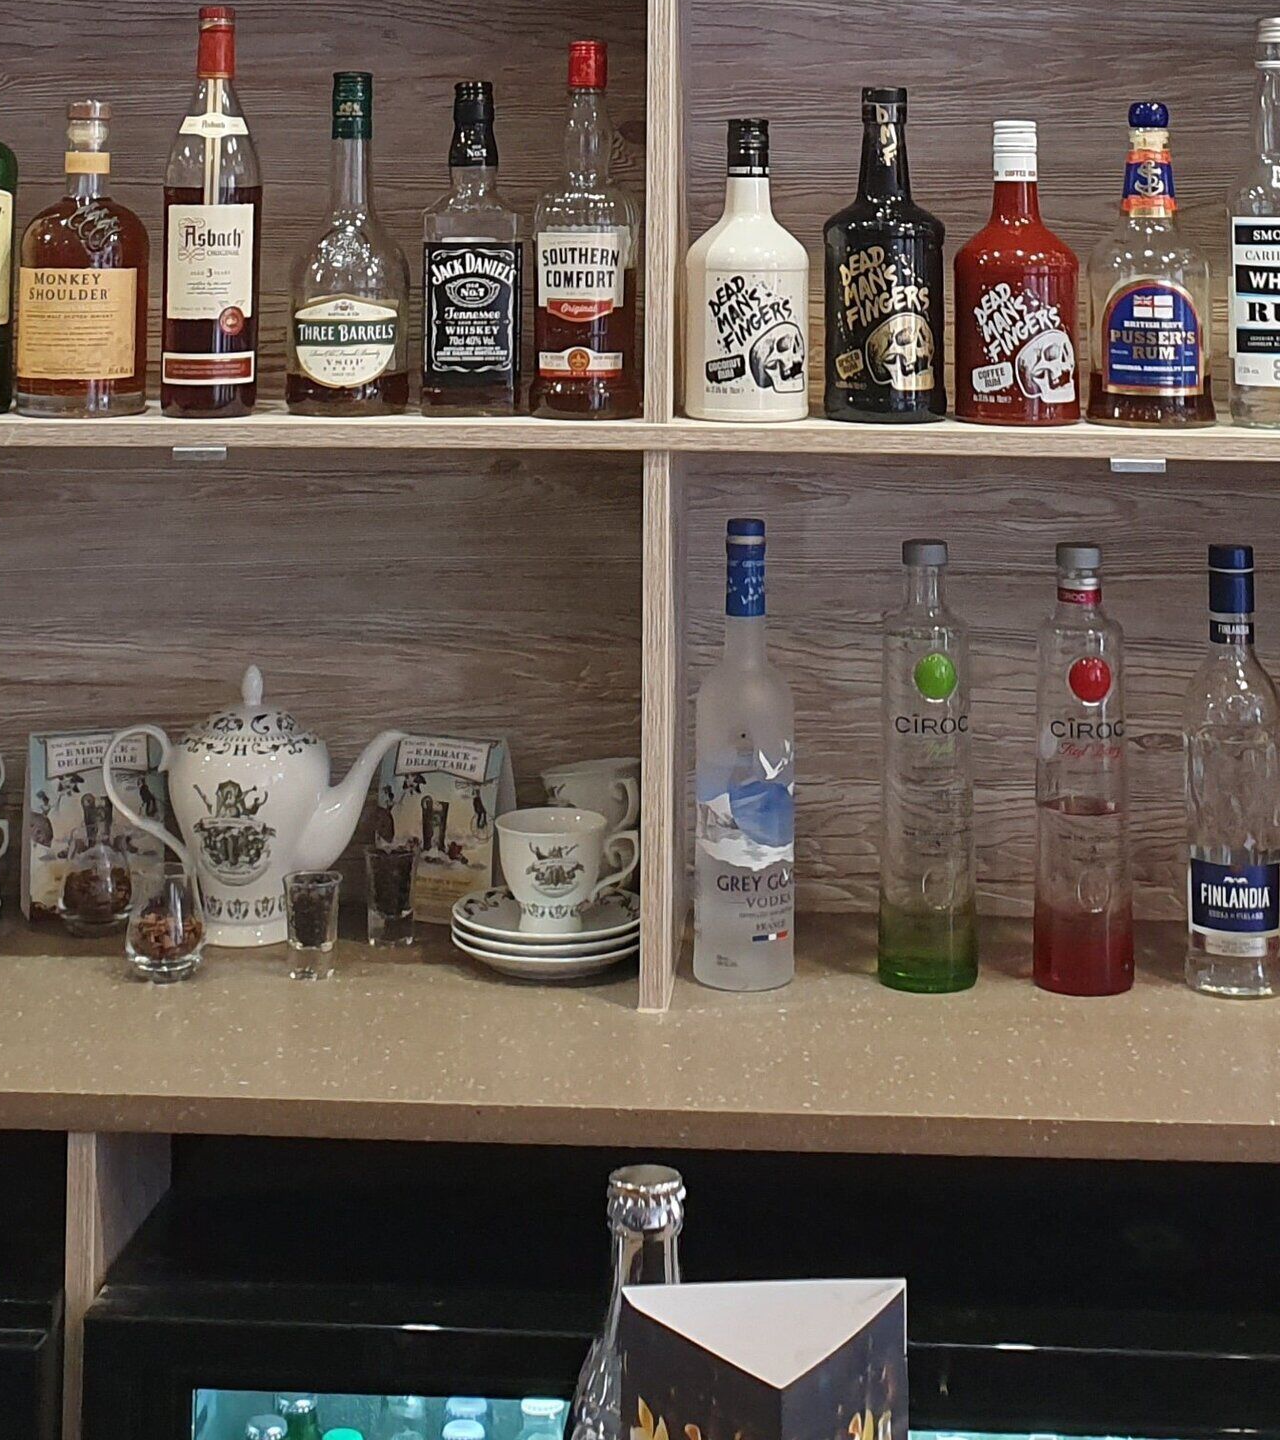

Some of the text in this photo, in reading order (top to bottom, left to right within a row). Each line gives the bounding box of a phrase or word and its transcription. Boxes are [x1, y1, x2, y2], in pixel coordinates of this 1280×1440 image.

[184, 225, 243, 249] Asbach
[542, 247, 621, 267] SOUTHERN
[838, 245, 886, 287] DEAD
[206, 268, 214, 279] 3
[430, 251, 518, 285] JACK DANIEL'S
[33, 271, 102, 286] MONKEY
[546, 270, 616, 289] COMFORT
[844, 263, 899, 306] MAN'S
[28, 286, 110, 301] SHOULDER
[460, 288, 486, 299] No.7
[708, 274, 746, 318] DEAD
[444, 306, 501, 320] Tennessee
[715, 286, 761, 336] MAN'S
[845, 283, 931, 332] FINGERS
[973, 282, 1011, 327] DEAD
[721, 297, 793, 353] FINGERS
[981, 294, 1028, 343] MAN'S
[298, 323, 396, 342] THREE BARRELS
[445, 324, 501, 336] WHISKEY
[986, 306, 1061, 363] FINGERS
[1110, 328, 1197, 347] PUSSER'S
[1132, 345, 1177, 361] RUM
[977, 369, 1006, 381] COFFEE
[894, 713, 970, 735] CÎROC
[1050, 718, 1125, 741] CÎROC
[415, 746, 469, 762] EMBRACE
[404, 757, 476, 774] DELECTABLE
[716, 874, 762, 893] GREY
[1201, 882, 1271, 909] FINLANDIA
